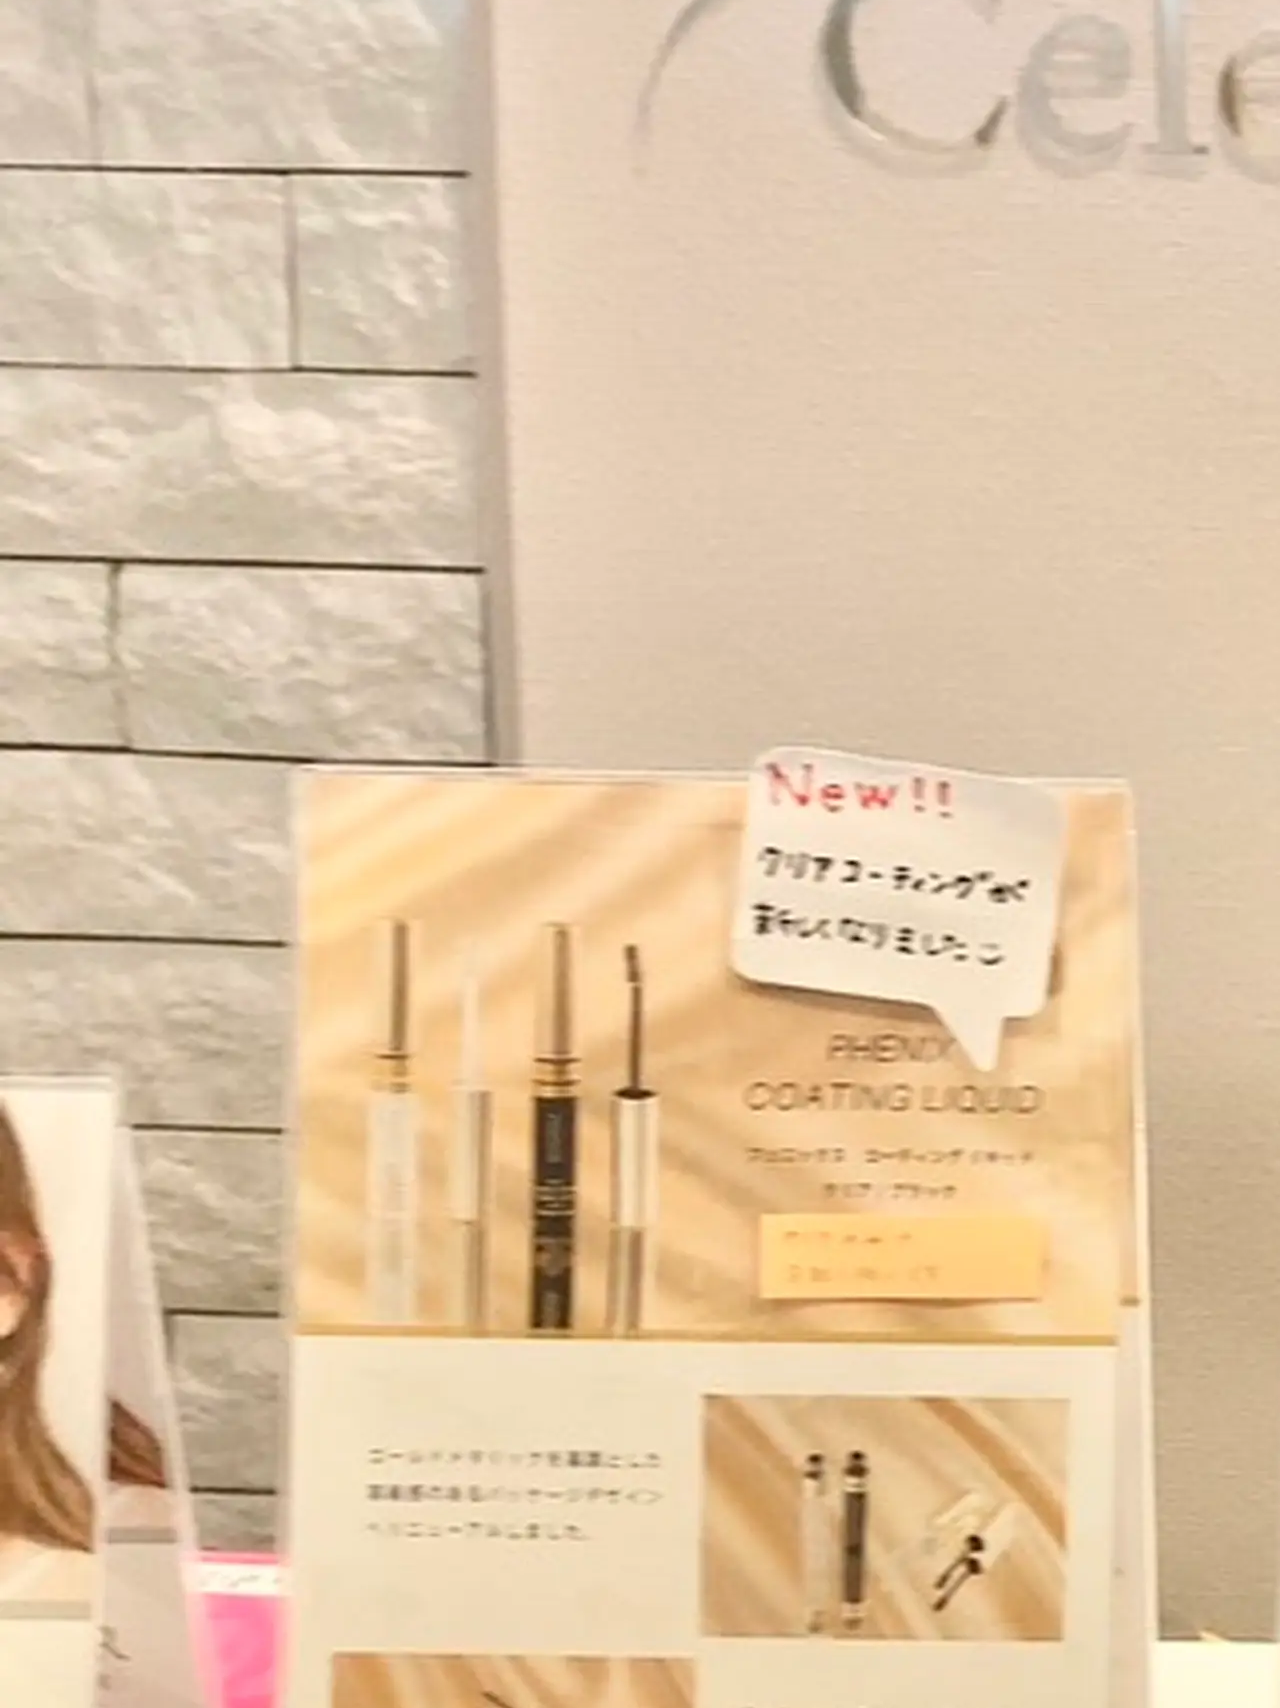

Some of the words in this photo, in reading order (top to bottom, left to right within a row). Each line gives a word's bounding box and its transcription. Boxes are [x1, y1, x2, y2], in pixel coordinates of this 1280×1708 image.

[764, 761, 954, 819] New!!
[742, 1080, 914, 1112] COATING
[920, 1083, 1046, 1115] LIQUID
